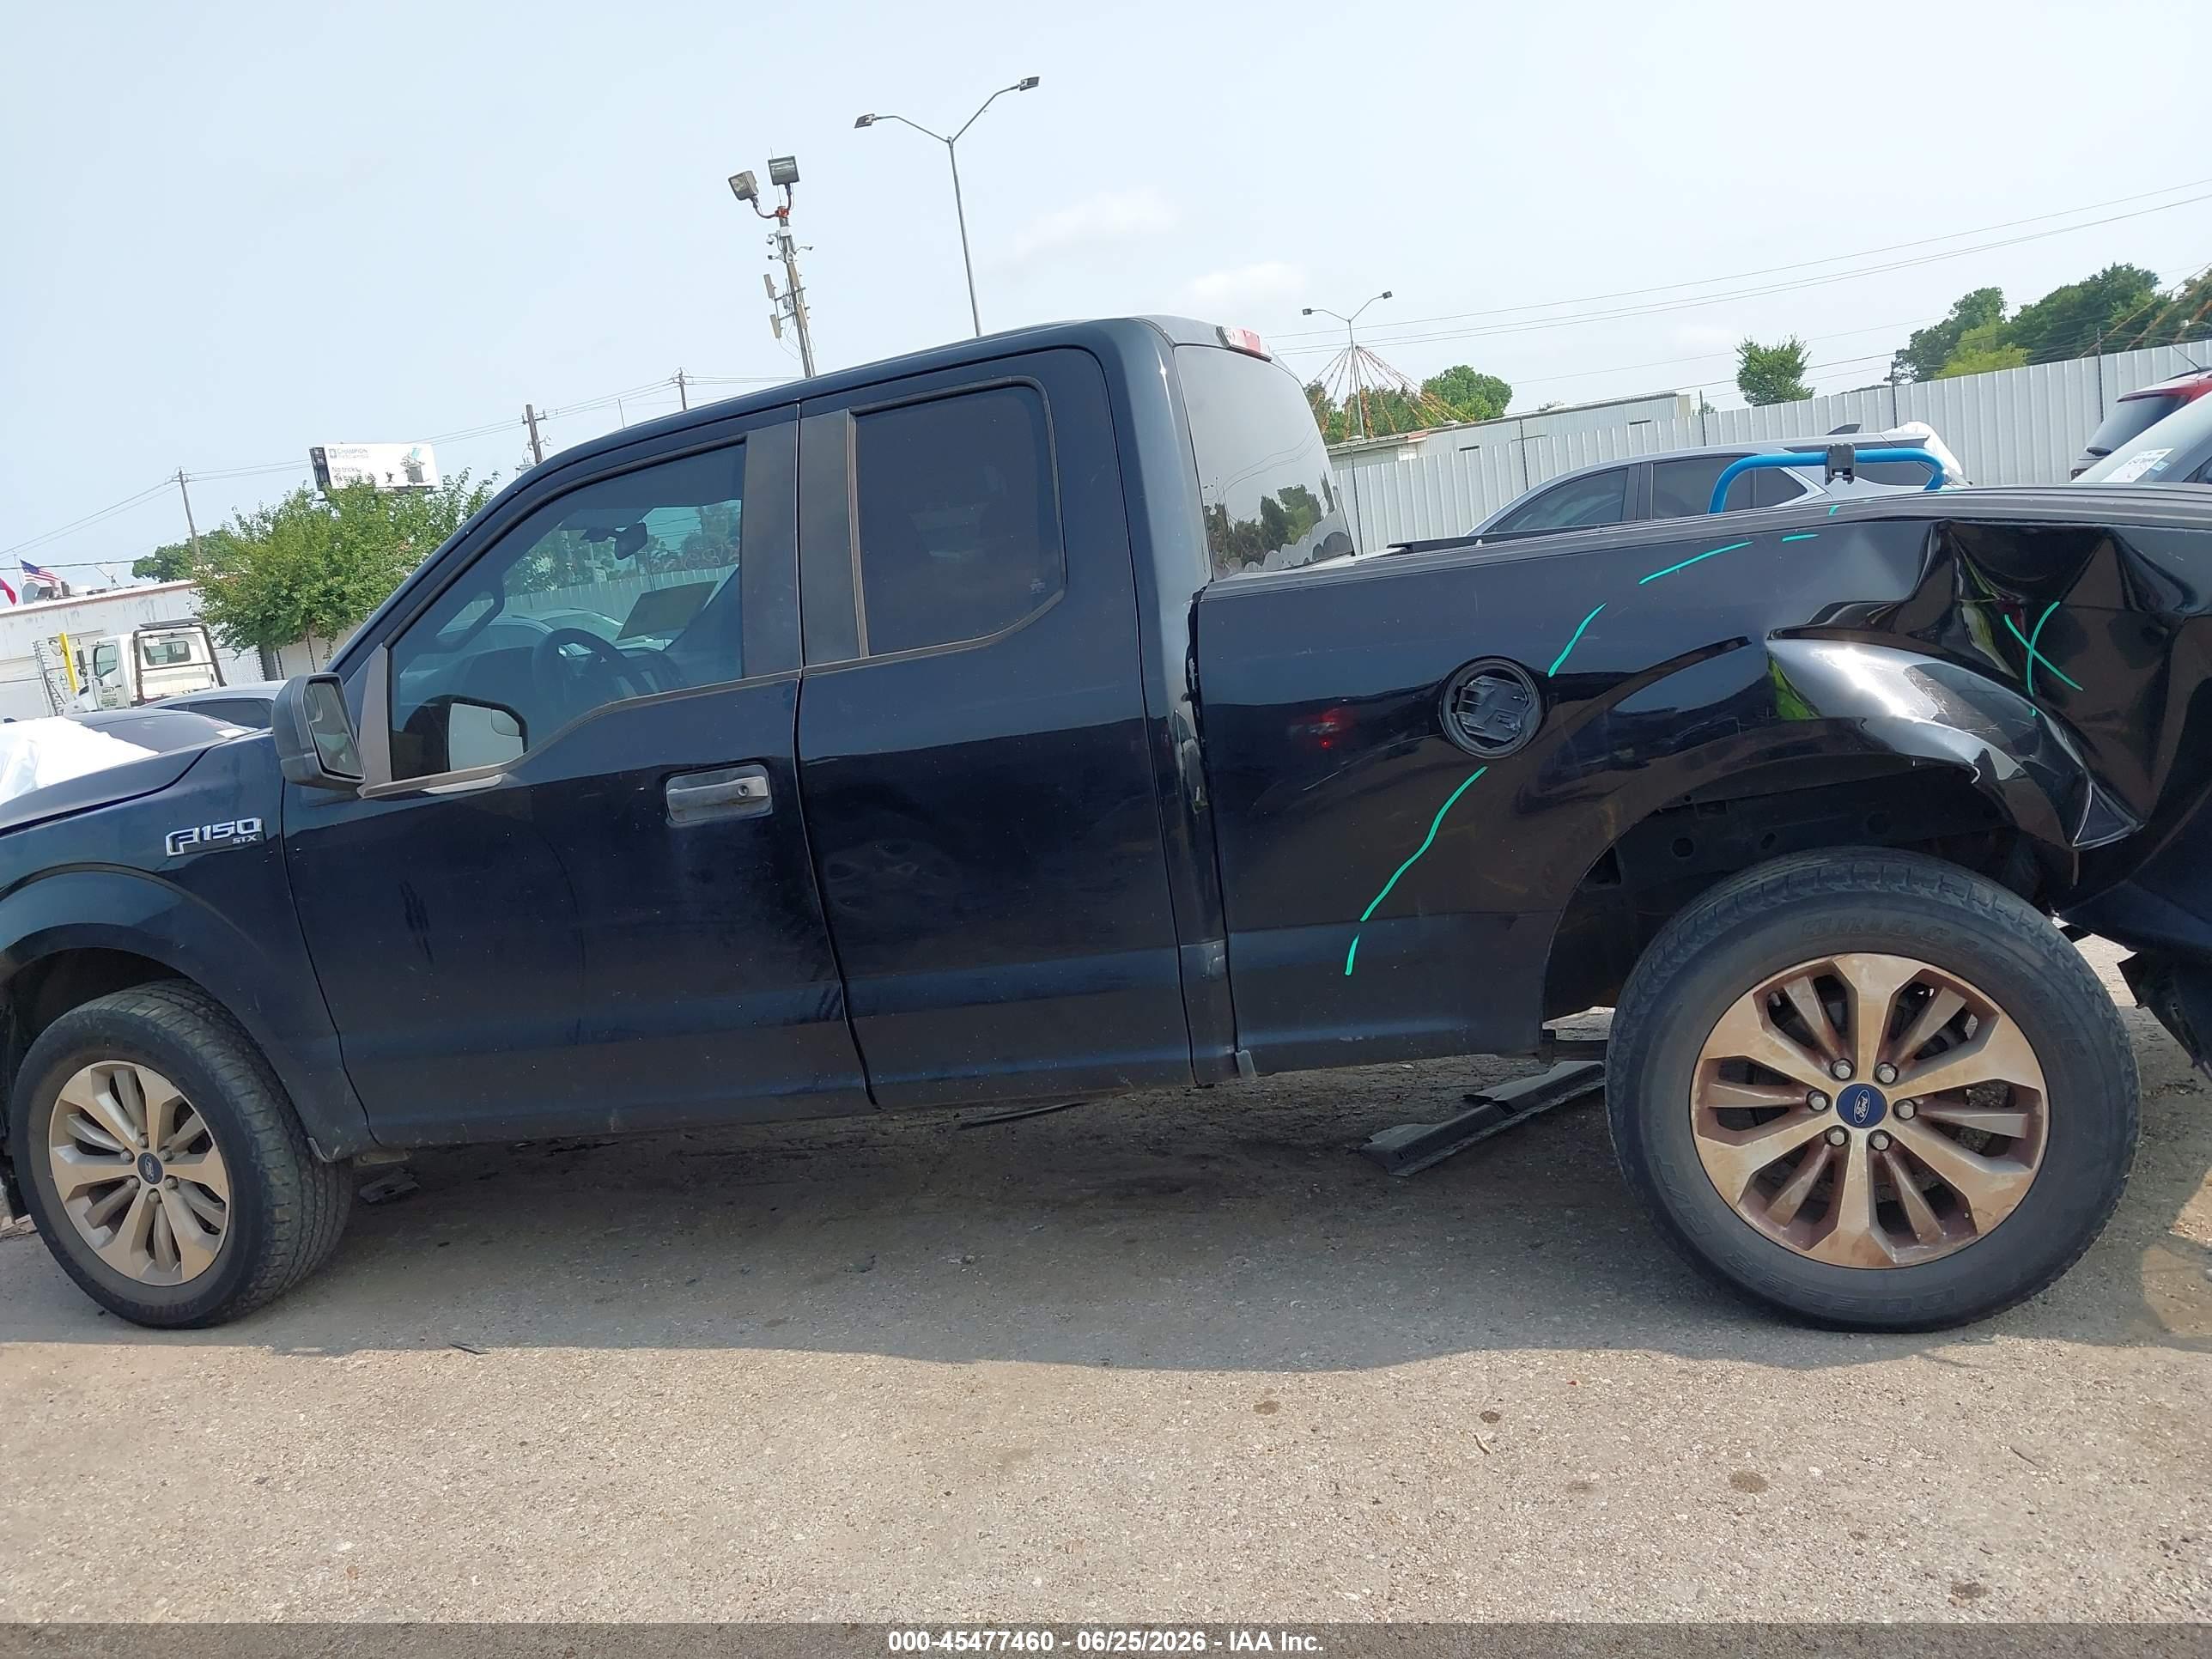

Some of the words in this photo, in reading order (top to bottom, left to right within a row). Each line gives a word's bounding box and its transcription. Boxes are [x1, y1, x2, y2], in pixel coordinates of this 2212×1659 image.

[166, 817, 262, 856] F150
[232, 834, 257, 844] STX
[1855, 1096, 1869, 1118] Ford
